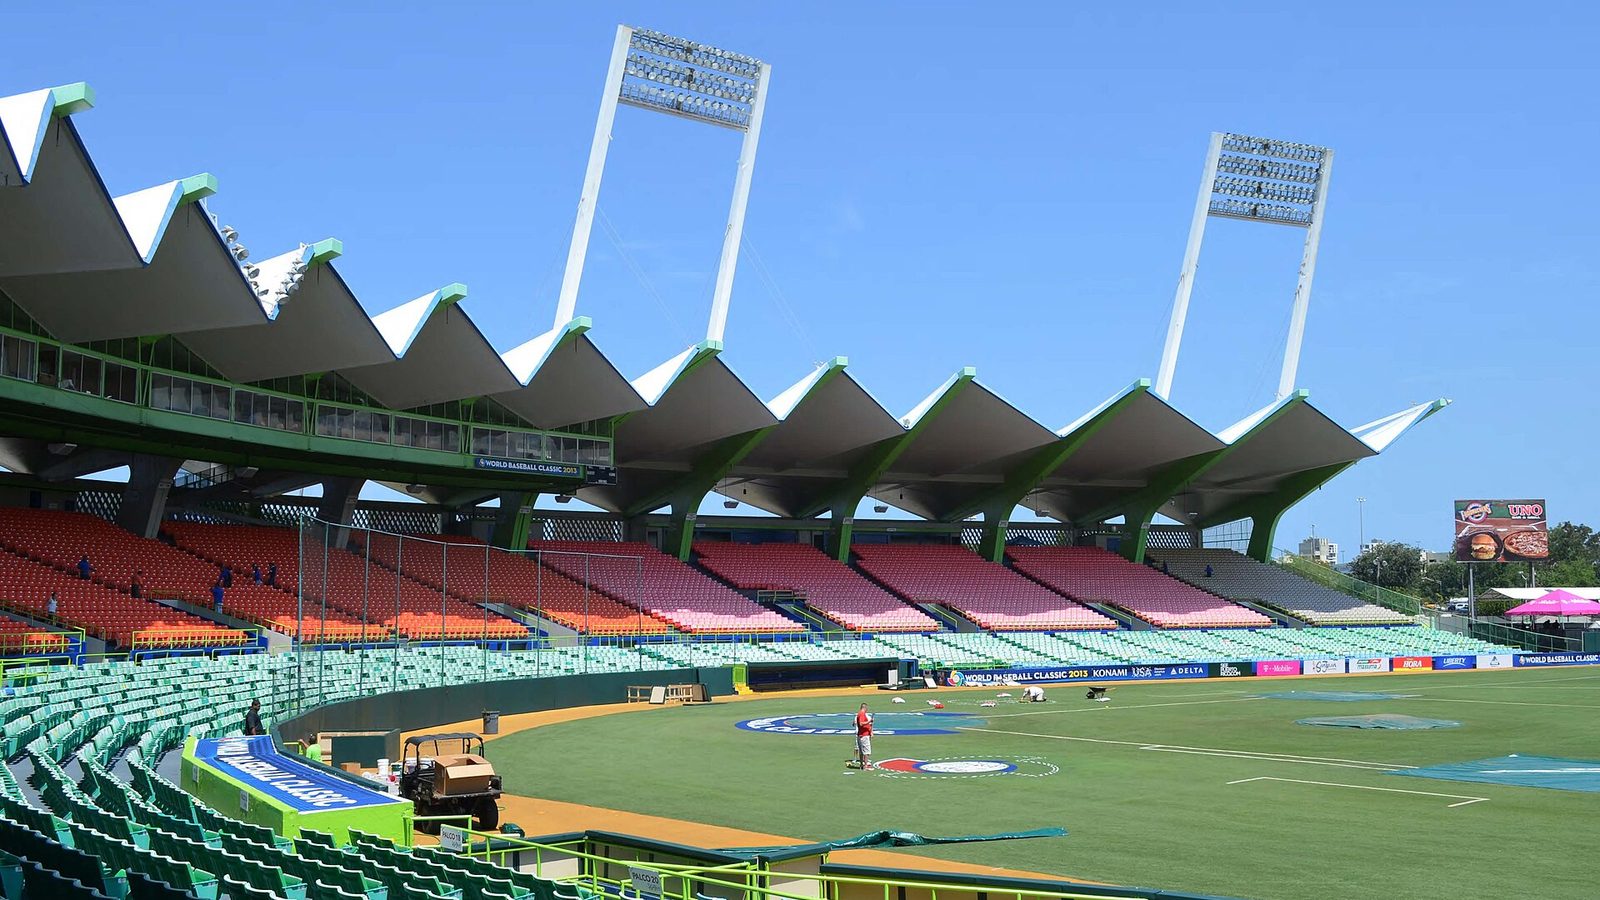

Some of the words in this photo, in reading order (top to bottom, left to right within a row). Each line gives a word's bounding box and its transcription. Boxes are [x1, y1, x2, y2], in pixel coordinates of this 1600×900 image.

[485, 460, 507, 468] WORLD
[508, 463, 537, 471] BASEBALL
[538, 465, 562, 473] CLASSIC
[1508, 504, 1543, 516] UNO
[1547, 655, 1575, 663] BASEBALL
[1576, 654, 1599, 662] CLASSIC
[965, 674, 992, 682] WORLD
[1034, 671, 1067, 680] CLASSIC
[1068, 670, 1088, 679] 2013
[1093, 669, 1128, 678] KONAMI
[1131, 666, 1153, 678] USA
[442, 831, 456, 841] PALCO
[631, 871, 651, 883] PALCO
[651, 875, 659, 884] 20
